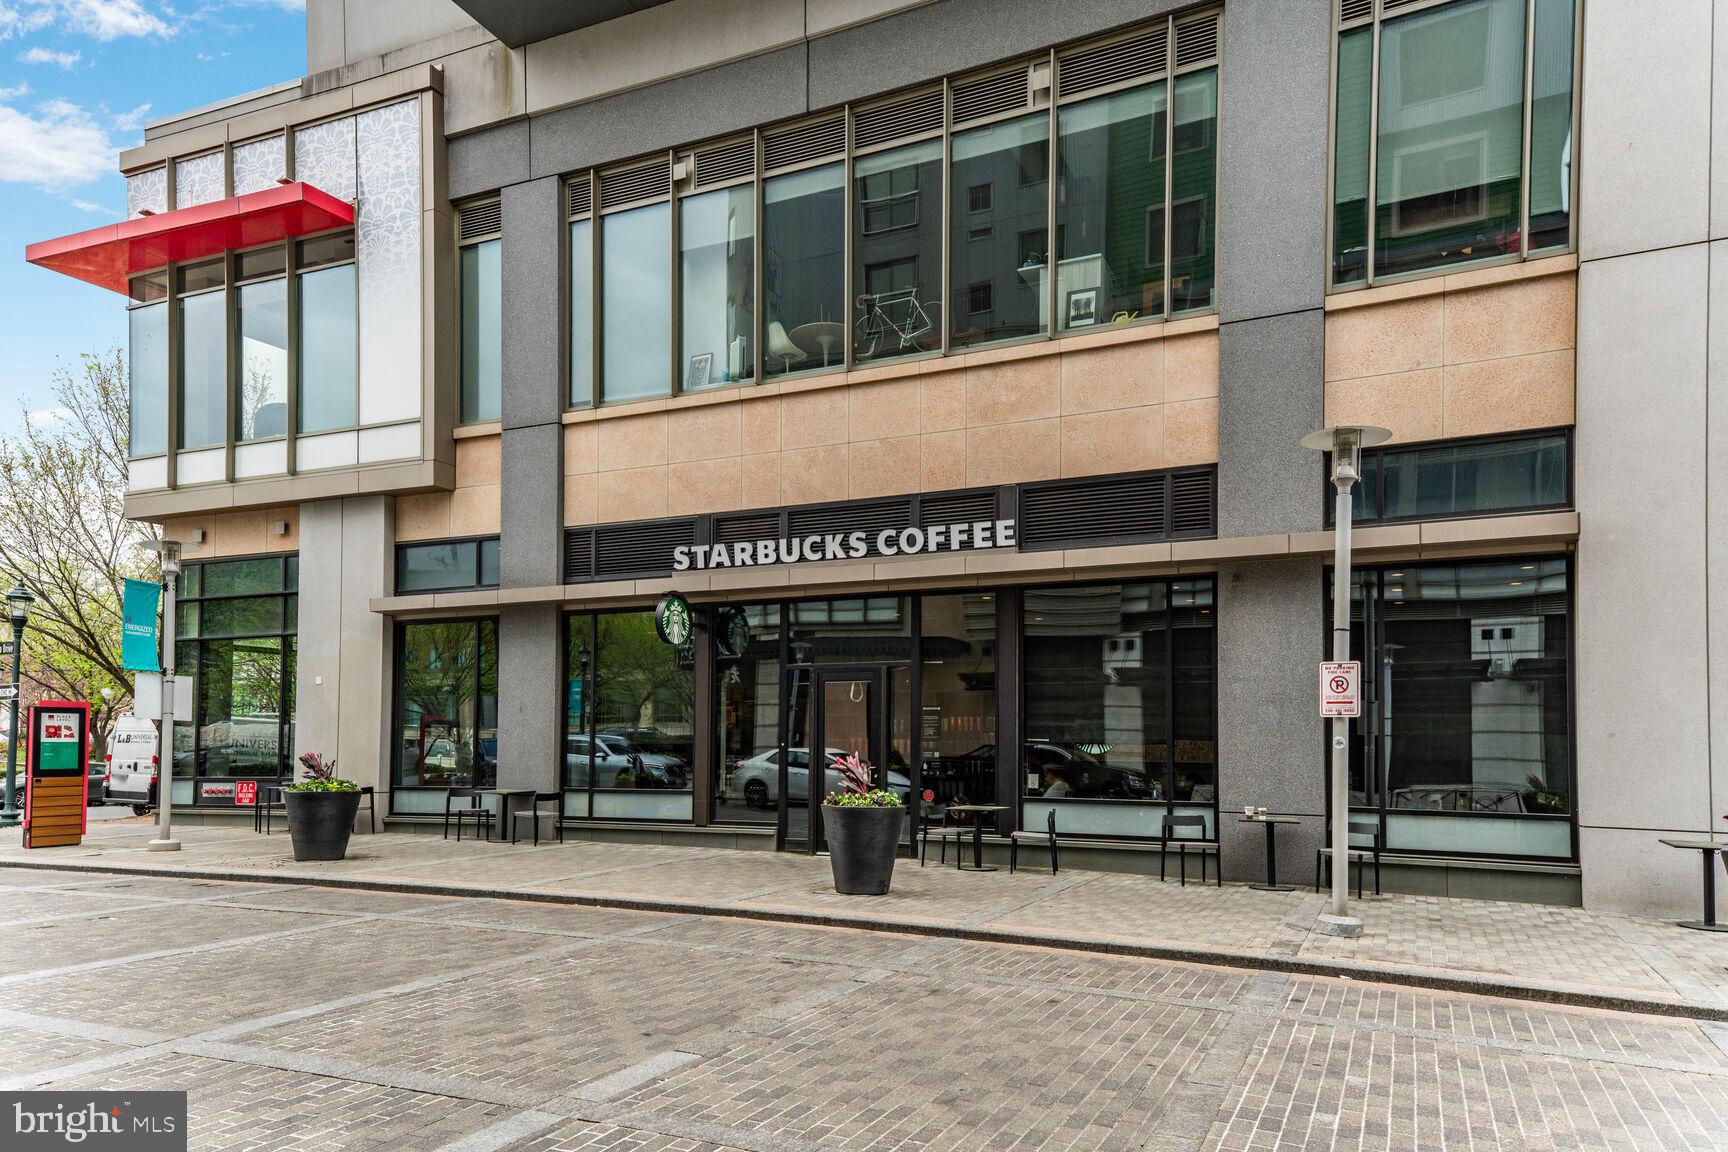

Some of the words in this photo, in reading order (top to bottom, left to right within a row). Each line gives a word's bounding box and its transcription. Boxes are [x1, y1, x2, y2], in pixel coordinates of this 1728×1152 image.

[673, 531, 867, 570] STARBUCKS
[877, 519, 1015, 555] COFFEE
[125, 623, 153, 633] ENERGIZED
